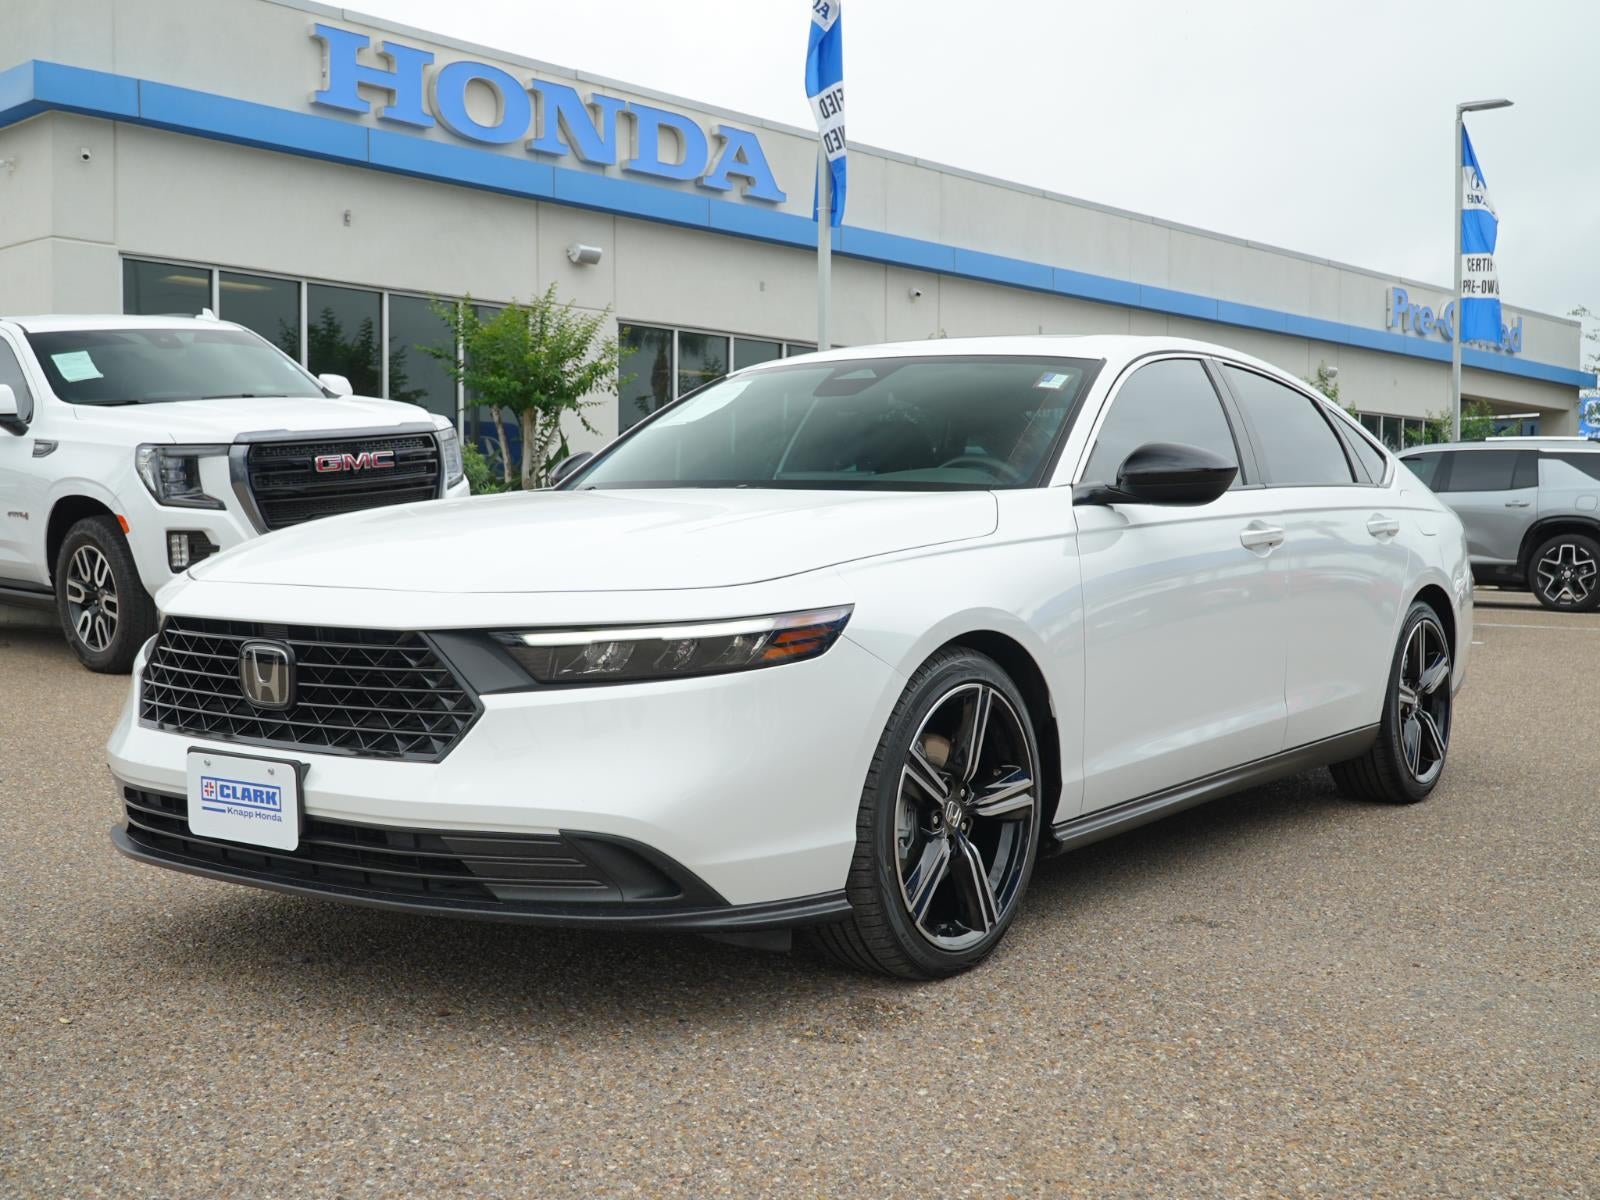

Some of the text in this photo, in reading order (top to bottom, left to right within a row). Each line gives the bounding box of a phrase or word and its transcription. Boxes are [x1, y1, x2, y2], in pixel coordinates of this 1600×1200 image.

[309, 22, 787, 203] HONDA
[314, 451, 395, 473] GMC
[219, 784, 278, 806] CLARK
[227, 806, 282, 822] Knapp Honda
